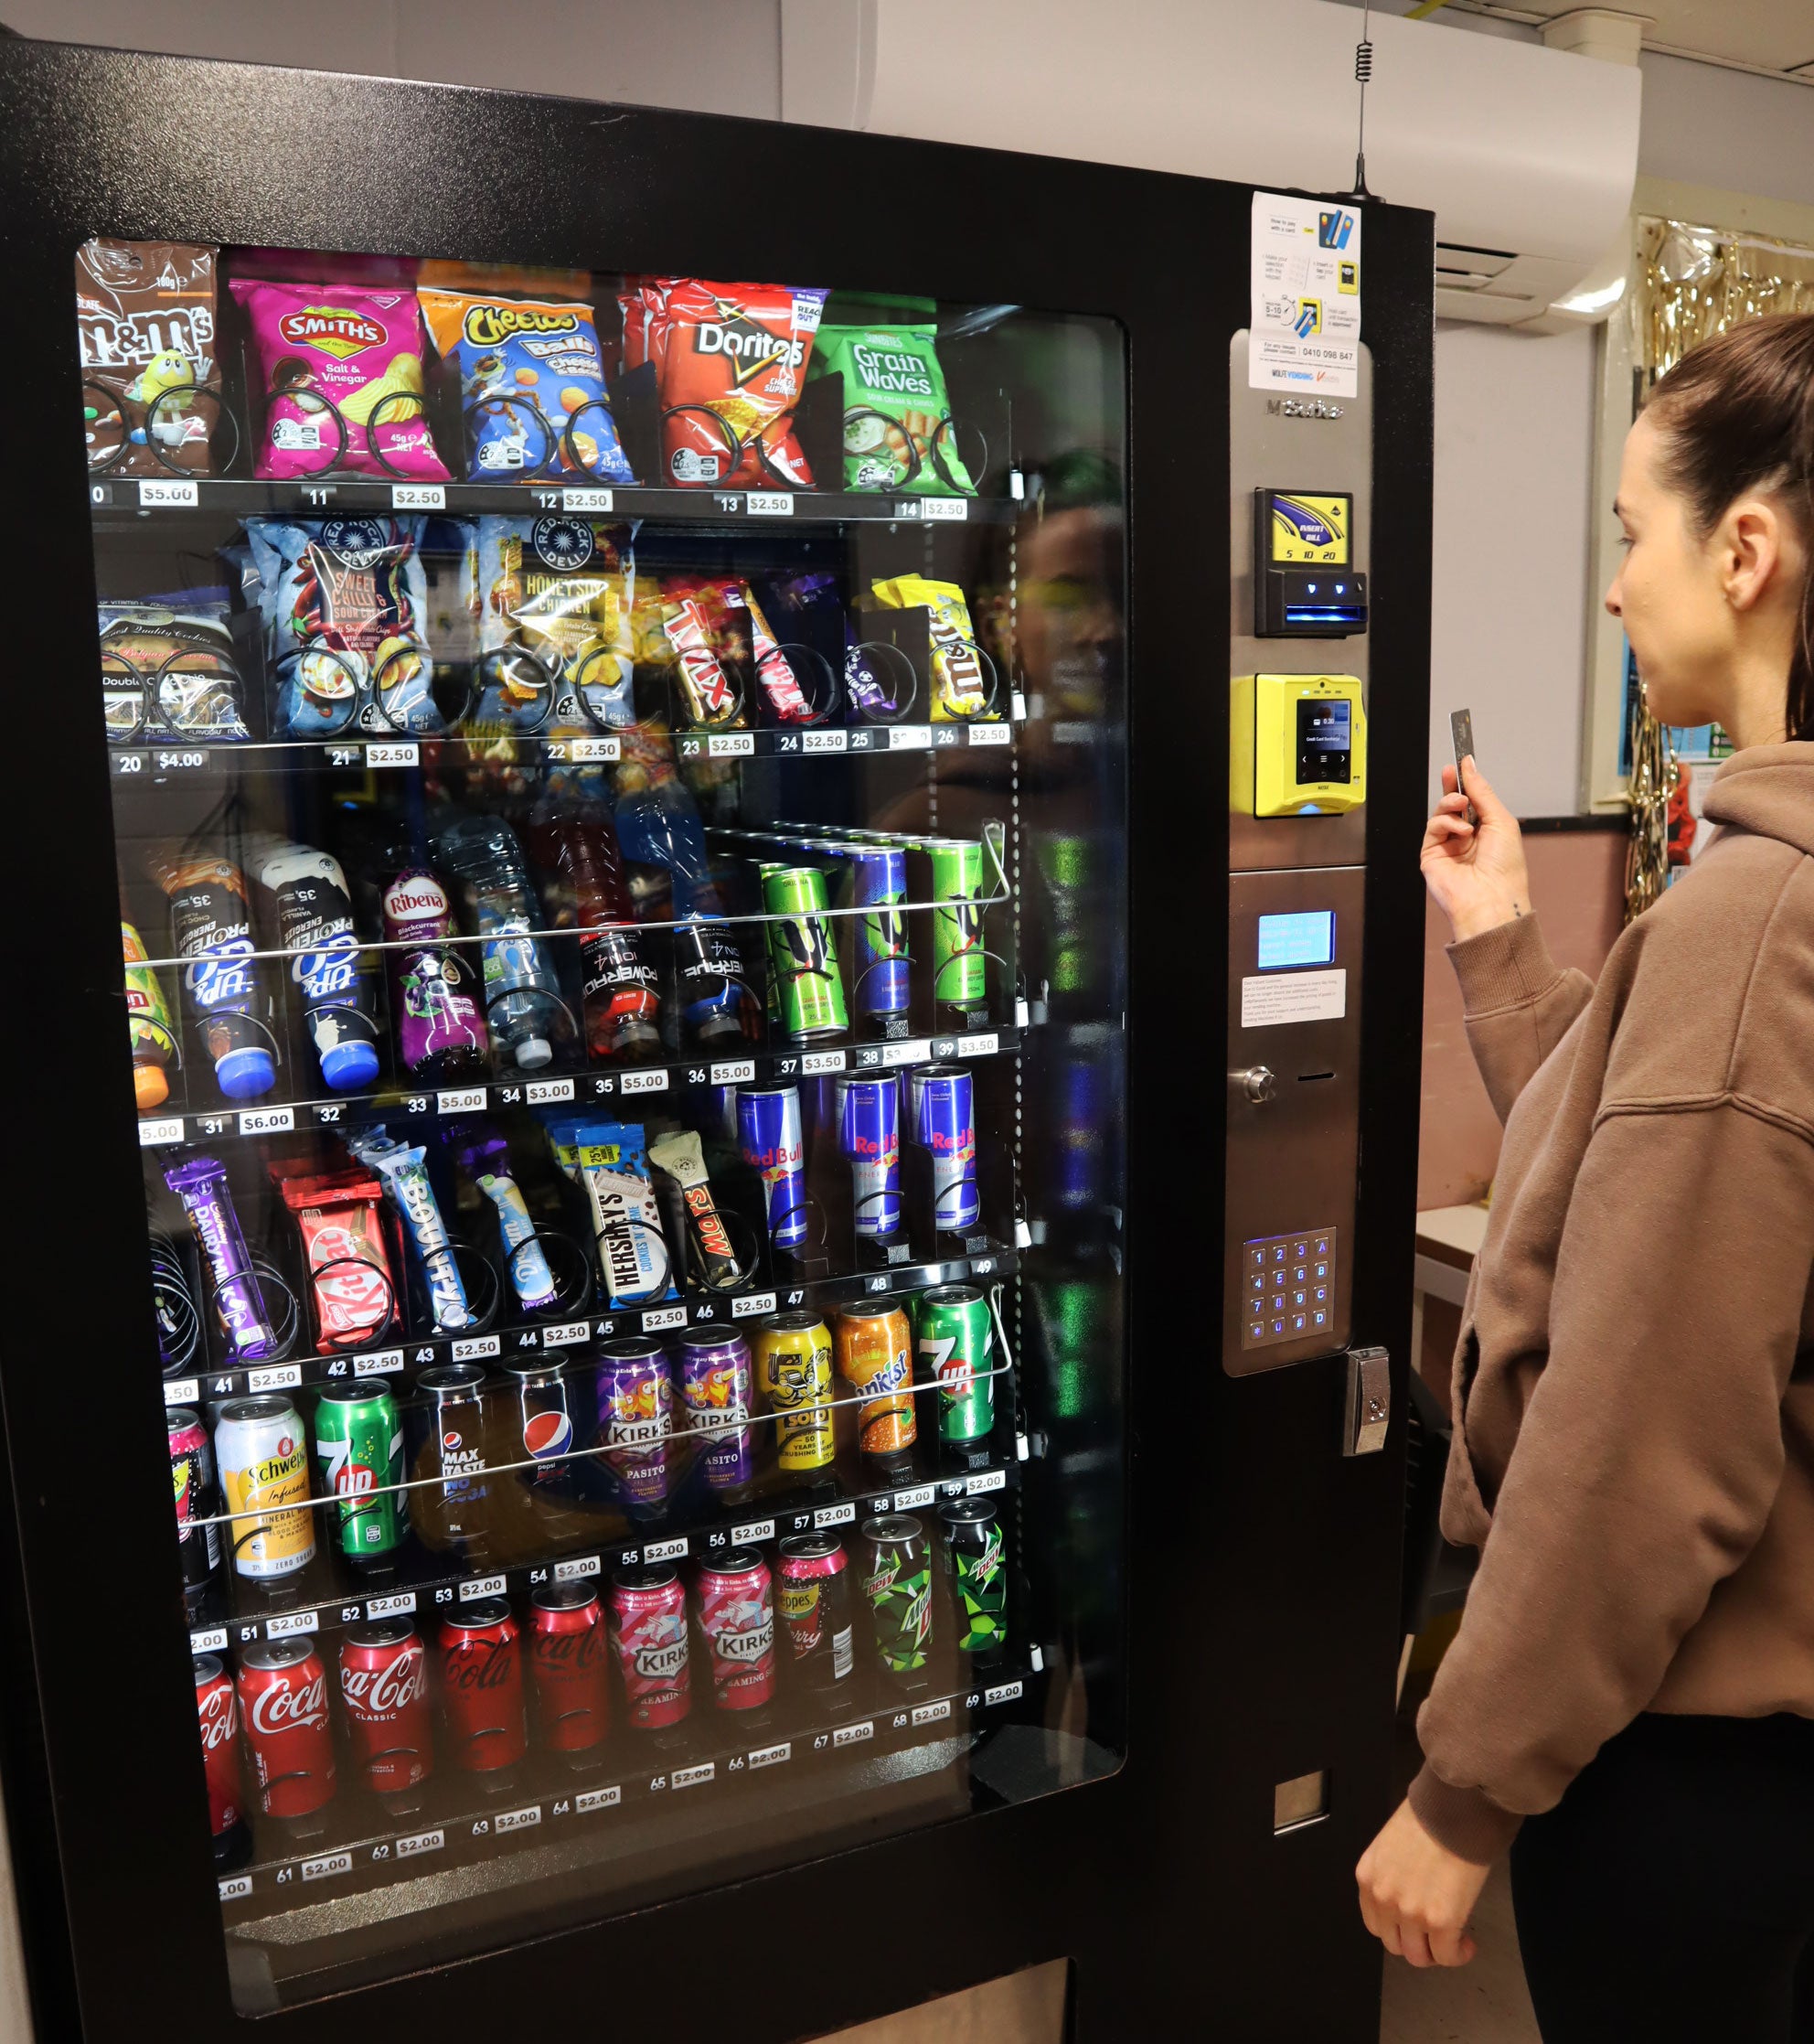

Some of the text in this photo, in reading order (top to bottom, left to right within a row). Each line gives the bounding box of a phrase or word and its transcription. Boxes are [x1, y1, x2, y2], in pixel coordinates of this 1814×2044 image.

[286, 316, 379, 343] SMITH'S
[530, 336, 595, 358] Balls
[699, 322, 805, 364] Doritos
[853, 344, 925, 373] Grain
[1303, 348, 1321, 358] 0410
[325, 363, 360, 373] Salt &
[1272, 369, 1287, 378] WOLFE
[322, 371, 367, 384] Vinegar
[858, 364, 932, 395] Waves
[310, 490, 327, 505] 11
[396, 491, 441, 504] $2.50
[566, 495, 607, 507] $2.50
[720, 498, 738, 512] 13
[750, 498, 788, 509] $2.50
[901, 502, 917, 516] 14
[1300, 524, 1324, 533] INSERT
[538, 518, 582, 567] RED DELI
[1286, 550, 1336, 560] 5 10 20
[335, 572, 377, 594] SWEET
[332, 591, 374, 606] CHILLI
[334, 609, 358, 619] SOUR
[664, 599, 735, 711] TWIX
[712, 739, 750, 751] $2.50
[781, 736, 798, 750] 24
[806, 735, 843, 747] $2.50
[851, 733, 869, 747] 25
[369, 749, 413, 761] $2.50
[548, 744, 566, 759] 22
[683, 741, 700, 755] 23
[160, 752, 203, 769] $4.00
[332, 751, 350, 765] 21
[390, 894, 443, 915] Ribena
[398, 920, 441, 936] Blackcurrant
[805, 1056, 842, 1069] $3.50
[862, 1051, 879, 1065] 38
[713, 1065, 751, 1079] $5.00
[781, 1059, 797, 1074] 37
[595, 1079, 614, 1094] 35
[624, 1076, 663, 1090] $5.00
[502, 1088, 520, 1103] 34
[528, 1085, 570, 1098] $3.00
[408, 1099, 427, 1113] 33
[320, 1107, 339, 1121] 32
[205, 1118, 223, 1133] 31
[244, 1115, 289, 1129] $6.00
[856, 1133, 889, 1154] Red
[933, 1129, 966, 1150] Red
[776, 1146, 804, 1165] Bull
[194, 1205, 220, 1253] DAIRY
[685, 1186, 732, 1257] Mars
[407, 1182, 462, 1301] BOUNTY
[598, 1193, 641, 1288] HERSHEY'S
[1256, 1242, 1326, 1263] 1 2 3 A
[977, 1261, 992, 1274] 49
[870, 1277, 887, 1290] 48
[1254, 1266, 1325, 1289] 4 5 6 B
[787, 1290, 804, 1304] 47
[1254, 1289, 1325, 1312] 7 8 9 C
[734, 1299, 772, 1313] $2.50
[646, 1311, 683, 1327] $2.50
[1317, 1312, 1324, 1323] D
[546, 1326, 586, 1342] $2.50
[596, 1322, 614, 1335] 45
[519, 1332, 538, 1346] 44
[455, 1342, 496, 1357] $2.50
[327, 1362, 347, 1375] 42
[357, 1355, 400, 1371] $2.50
[214, 1378, 233, 1392] 41
[252, 1371, 296, 1386] $2.50
[793, 1442, 816, 1450] YEARS
[444, 1448, 480, 1464] MAX
[538, 1462, 556, 1471] pepsi
[626, 1464, 666, 1480] PASITO
[947, 1483, 963, 1496] 59
[968, 1476, 1001, 1491] $2.00
[268, 1479, 306, 1504] Infused
[873, 1497, 890, 1512] 58
[794, 1514, 809, 1529] 57
[816, 1507, 851, 1524] $2.00
[734, 1525, 771, 1540] $2.00
[622, 1551, 638, 1565] 55
[646, 1544, 684, 1559] $2.00
[275, 1559, 293, 1570] ZERO
[558, 1561, 596, 1578] $2.00
[529, 1568, 548, 1584] 54
[434, 1589, 454, 1602] 53
[369, 1596, 411, 1612] $2.00
[341, 1607, 360, 1621] 52
[271, 1615, 314, 1632] $2.00
[444, 1632, 513, 1690] Cola
[987, 1685, 1019, 1701] $2.00
[966, 1694, 980, 1708] 69
[355, 1711, 397, 1721] CLASSIC
[892, 1714, 908, 1728] 68
[813, 1735, 829, 1750] 67
[835, 1727, 870, 1743] $2.00
[728, 1756, 745, 1771] 66
[579, 1790, 617, 1807] $2.00
[552, 1799, 570, 1815] 64
[472, 1819, 489, 1835] 63
[497, 1811, 538, 1828] $2.00
[371, 1844, 390, 1860] 62
[304, 1857, 347, 1877] $2.00
[276, 1867, 293, 1884] 61
